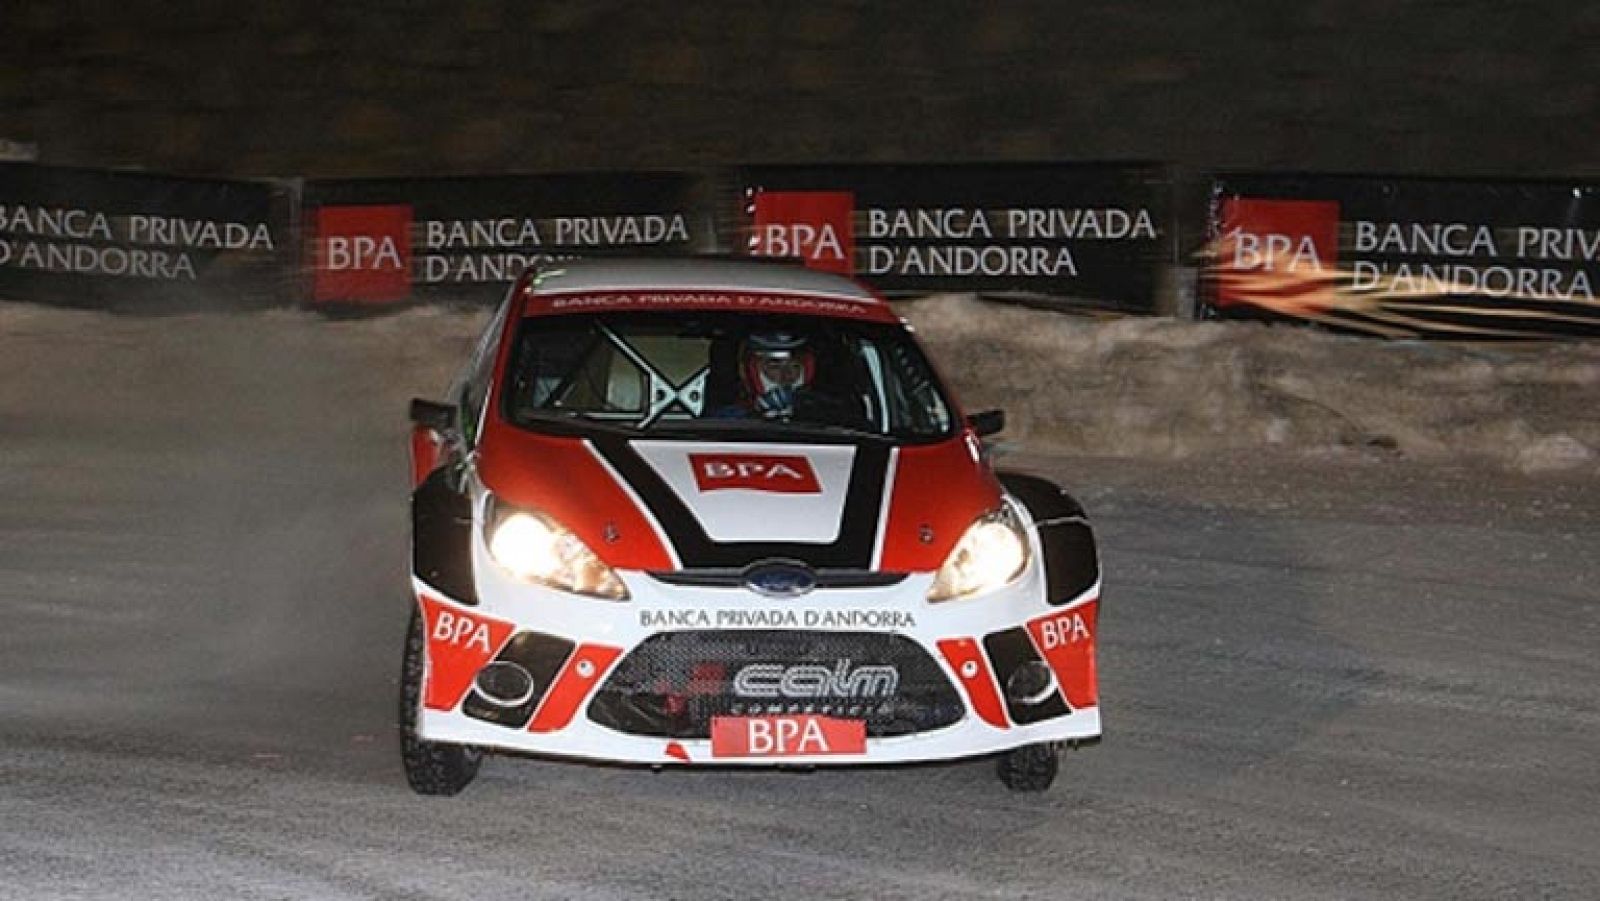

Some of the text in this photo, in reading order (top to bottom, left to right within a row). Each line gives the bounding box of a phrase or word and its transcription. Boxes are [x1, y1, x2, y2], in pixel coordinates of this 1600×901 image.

[129, 215, 274, 250] PRIVADA
[427, 213, 690, 249] BANCA PRIVADA
[765, 223, 845, 260] BPA
[868, 208, 1157, 239] BANCA PRIVADA
[1354, 220, 1600, 261] BANCA PRIV
[326, 237, 403, 270] BPA
[868, 245, 1077, 276] D'ANDORRA
[1233, 231, 1323, 273] BPA
[1351, 260, 1593, 301] D'ANDORRA
[552, 294, 632, 308] BANCA
[639, 293, 732, 304] PRIVADA
[703, 461, 804, 480] BPA
[432, 610, 492, 654] BPA
[639, 608, 916, 628] BANCA PRIVADA D'ANDORRA
[1040, 612, 1090, 651] BPA
[748, 717, 830, 754] BPA
